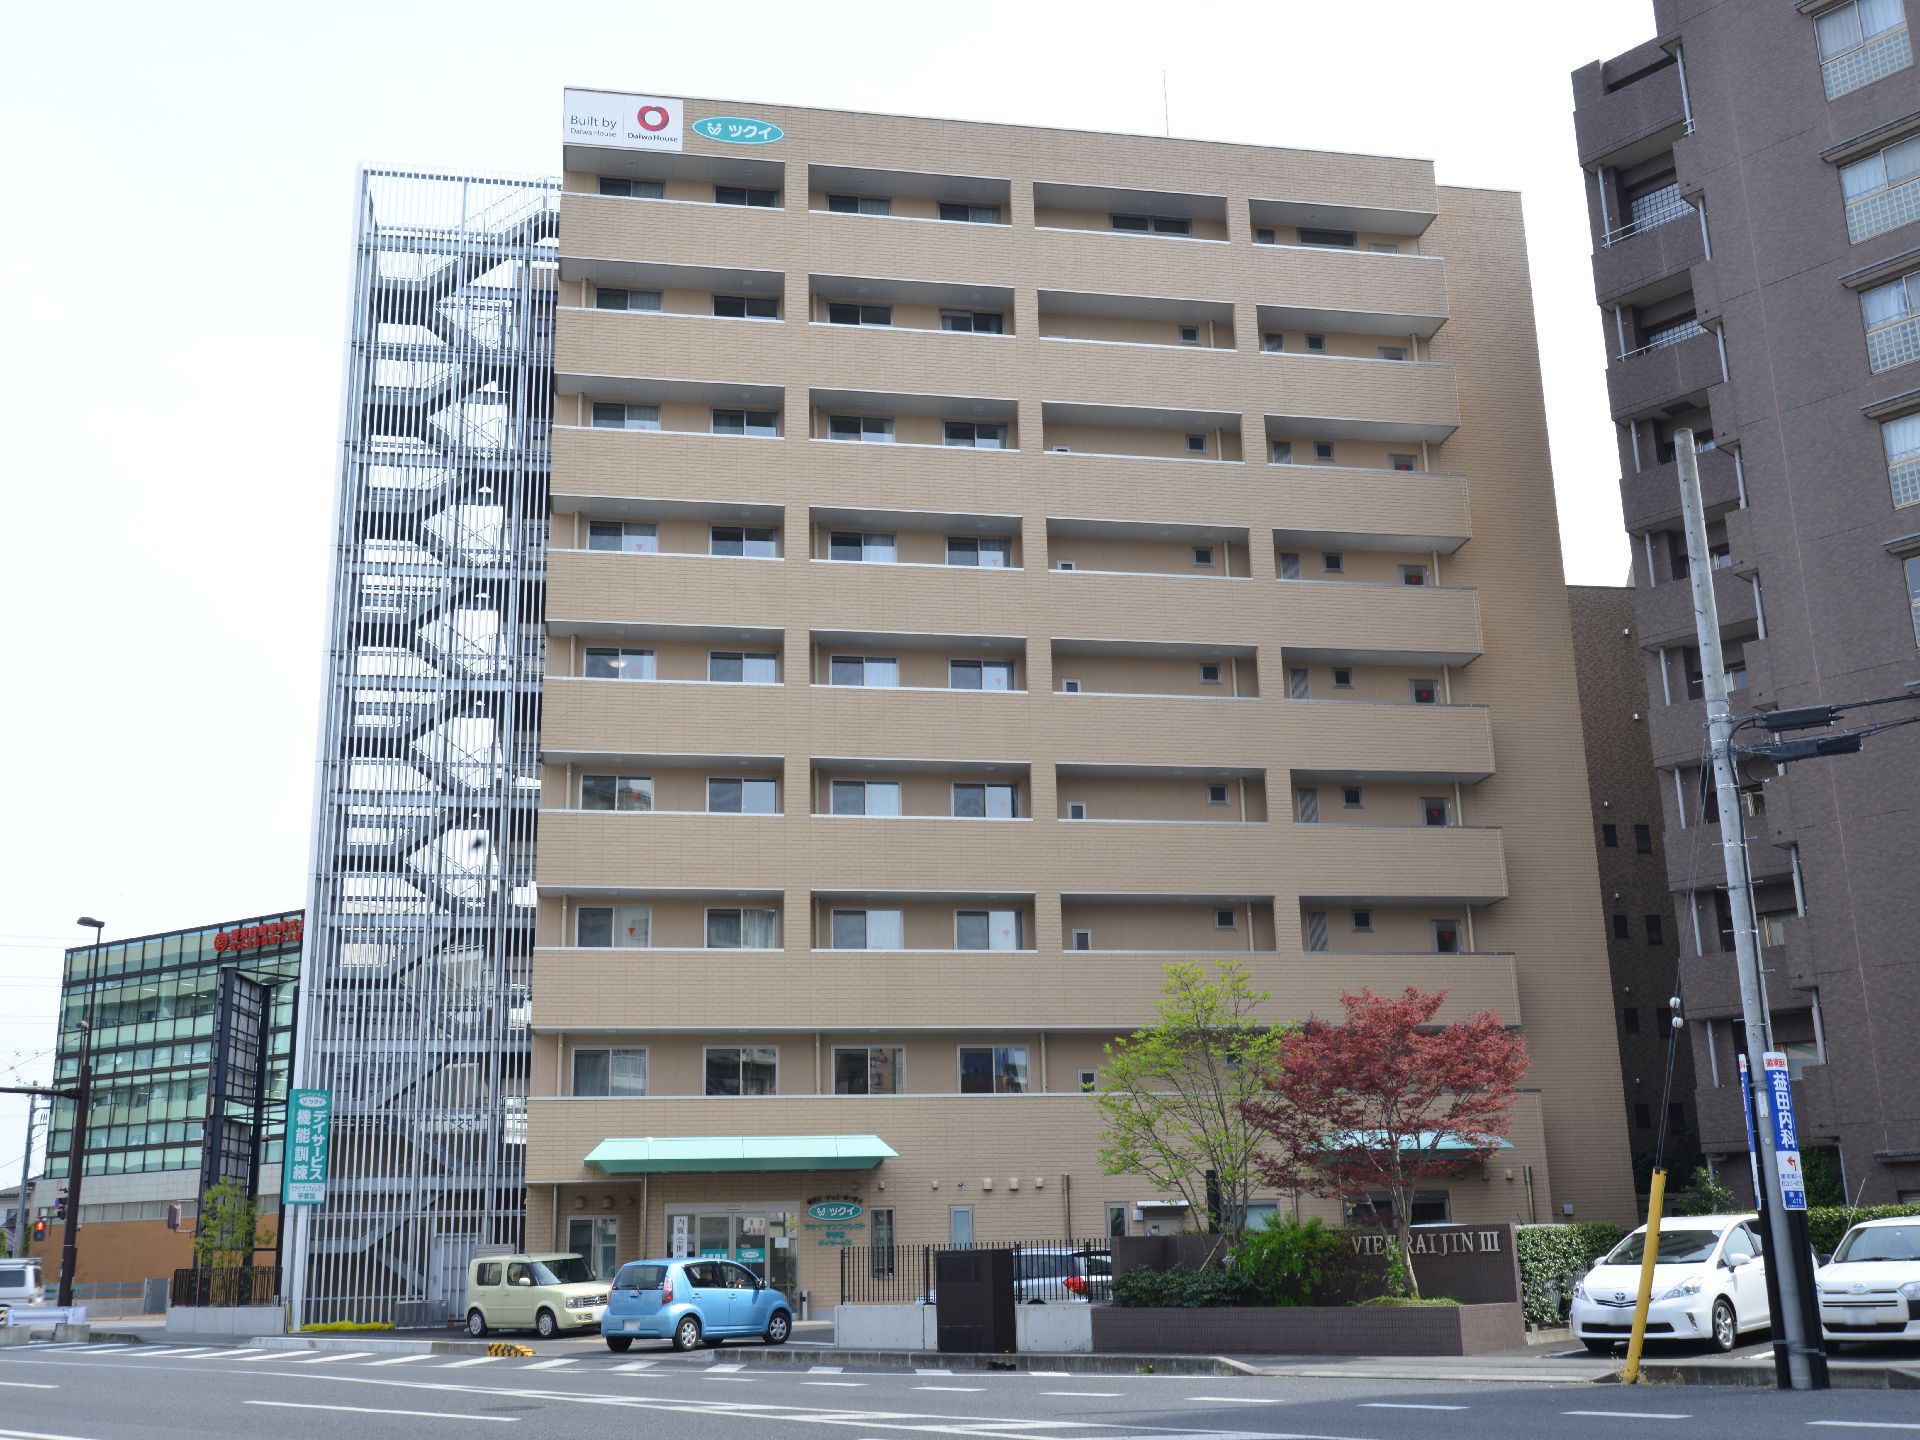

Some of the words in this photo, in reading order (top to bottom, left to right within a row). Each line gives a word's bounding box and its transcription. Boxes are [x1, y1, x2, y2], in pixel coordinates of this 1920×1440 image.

[570, 115, 598, 127] Built
[602, 117, 617, 130] by
[570, 128, 592, 136] Daiwa
[728, 124, 772, 140] ツクイ
[292, 1109, 312, 1181] 機能訓練
[309, 1109, 327, 1181] デイサービス
[829, 1206, 855, 1216] ツクイ
[1408, 1231, 1475, 1257] RAIJIN
